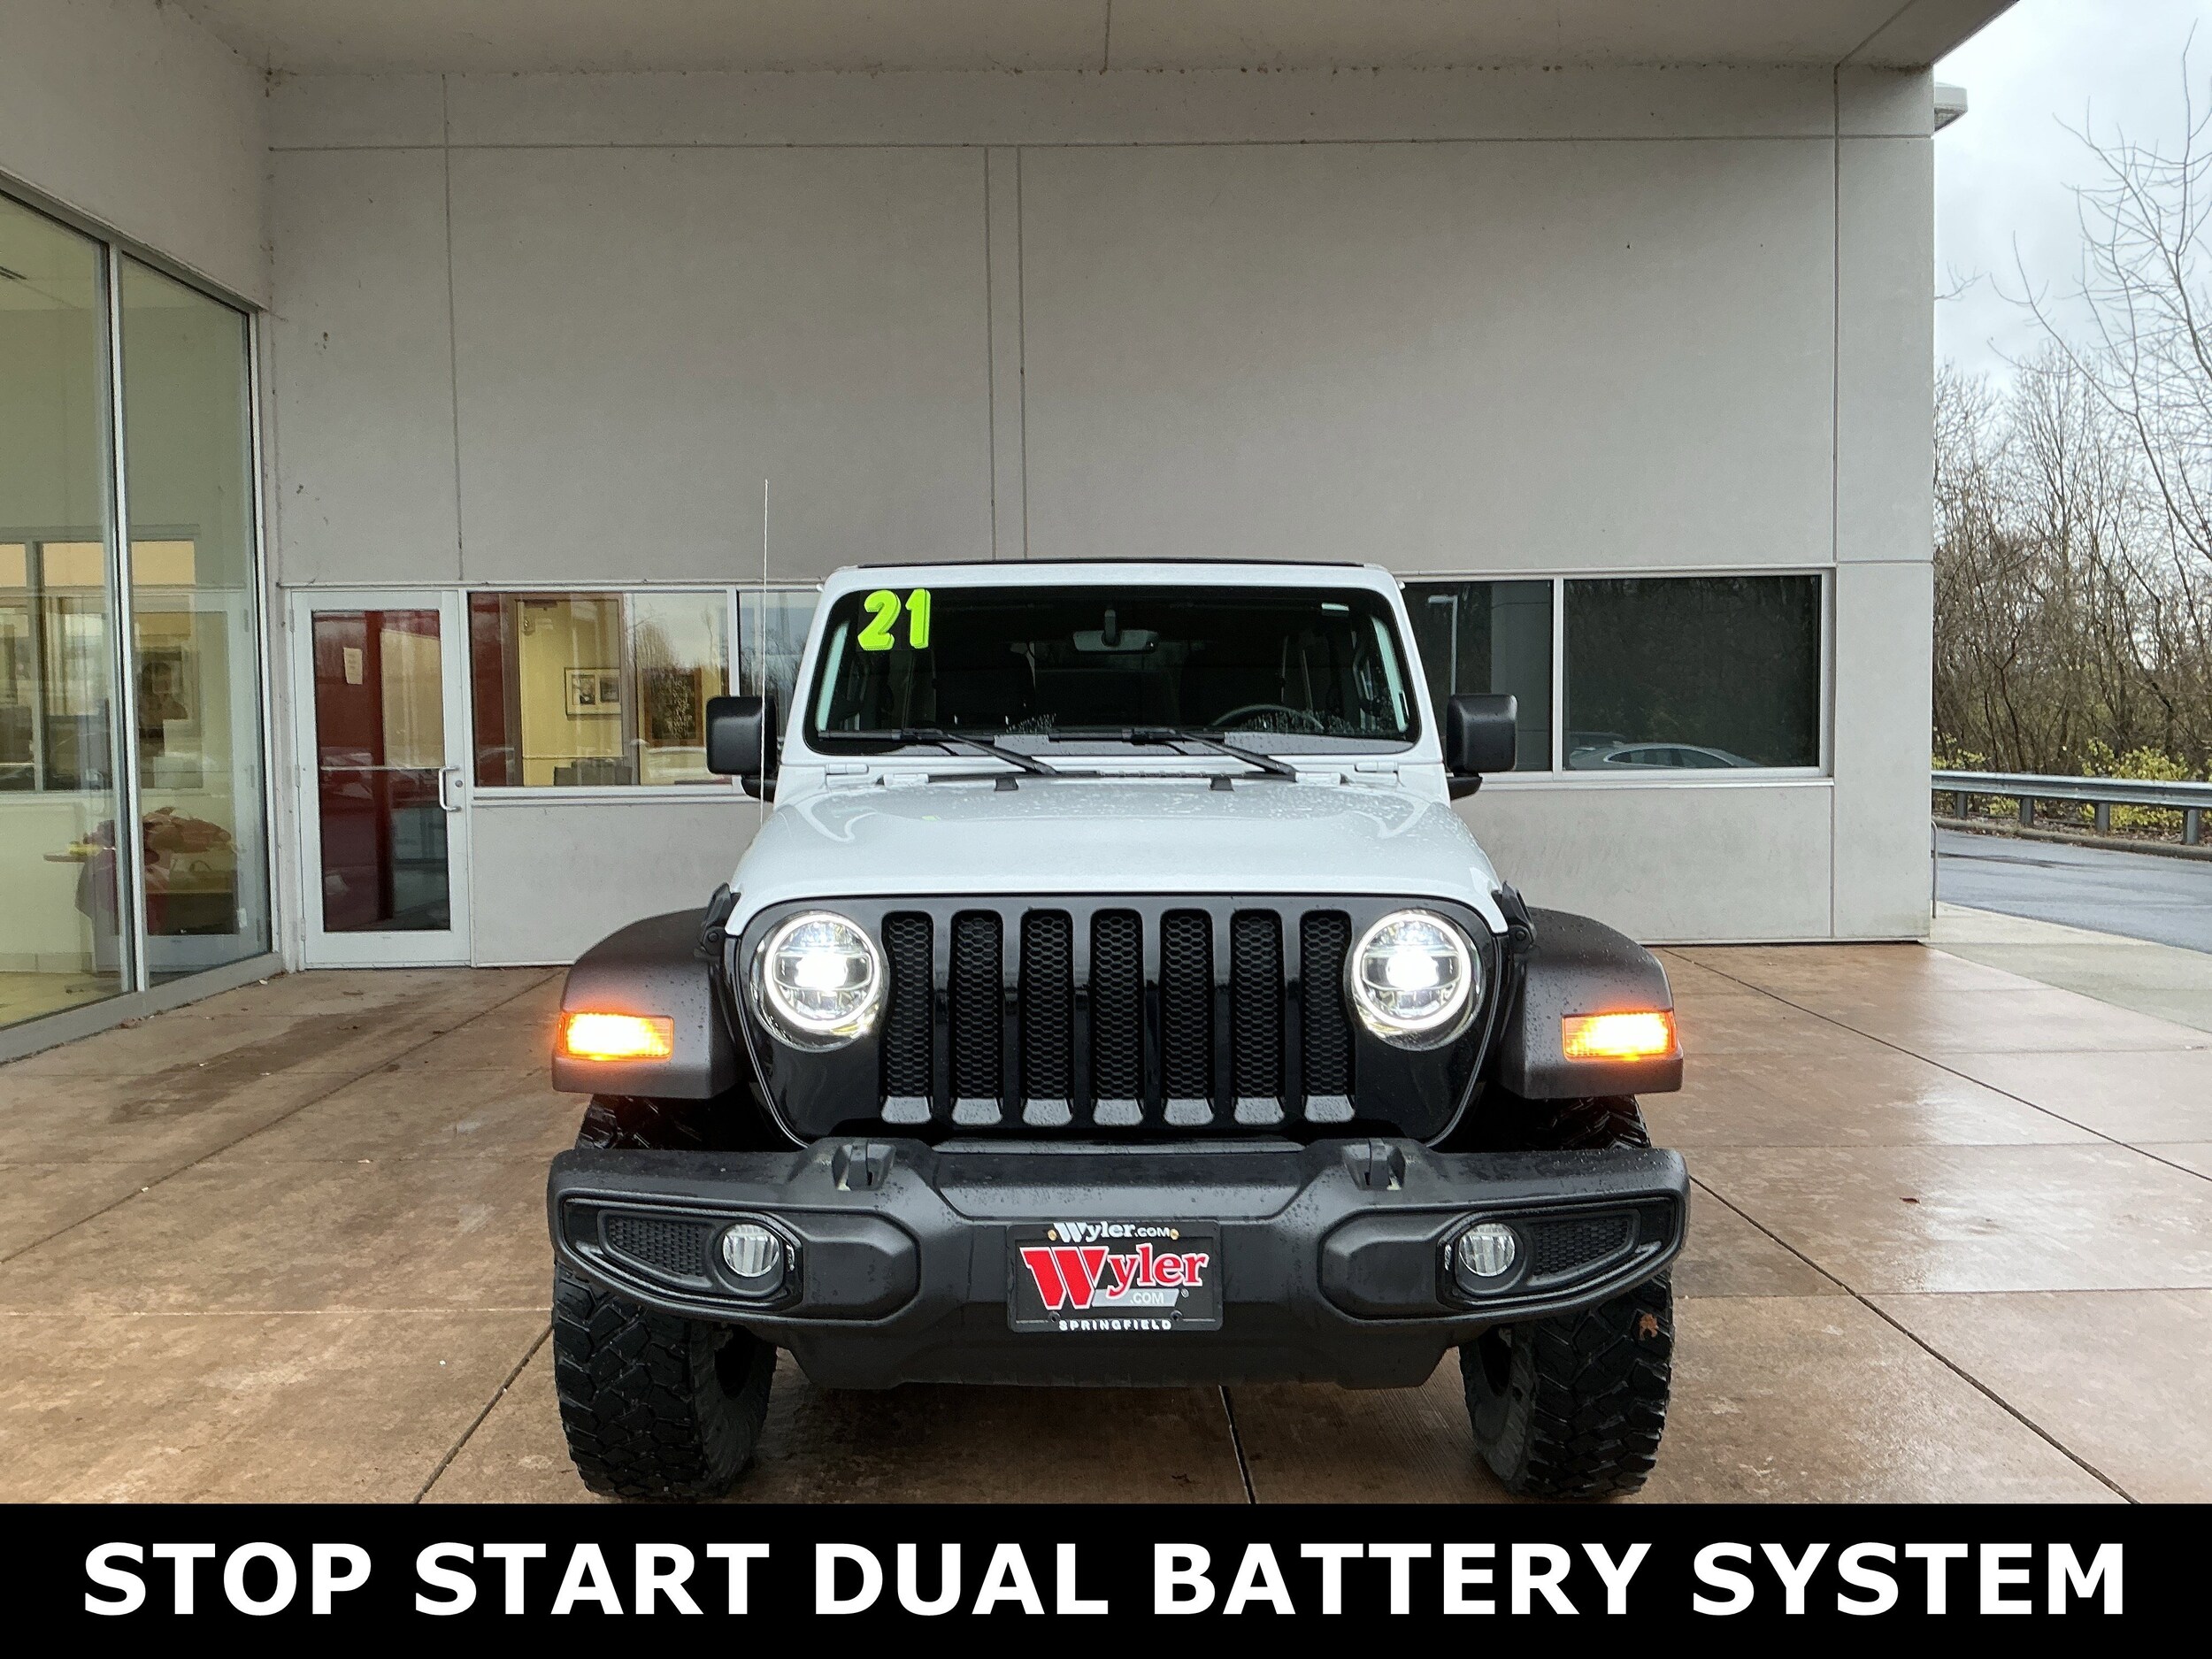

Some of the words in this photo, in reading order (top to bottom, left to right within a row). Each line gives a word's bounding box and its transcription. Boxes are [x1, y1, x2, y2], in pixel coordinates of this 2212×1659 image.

[857, 588, 931, 650] 21
[1019, 1243, 1210, 1310] Wyler
[1058, 1319, 1171, 1331] SPRINGFIELD
